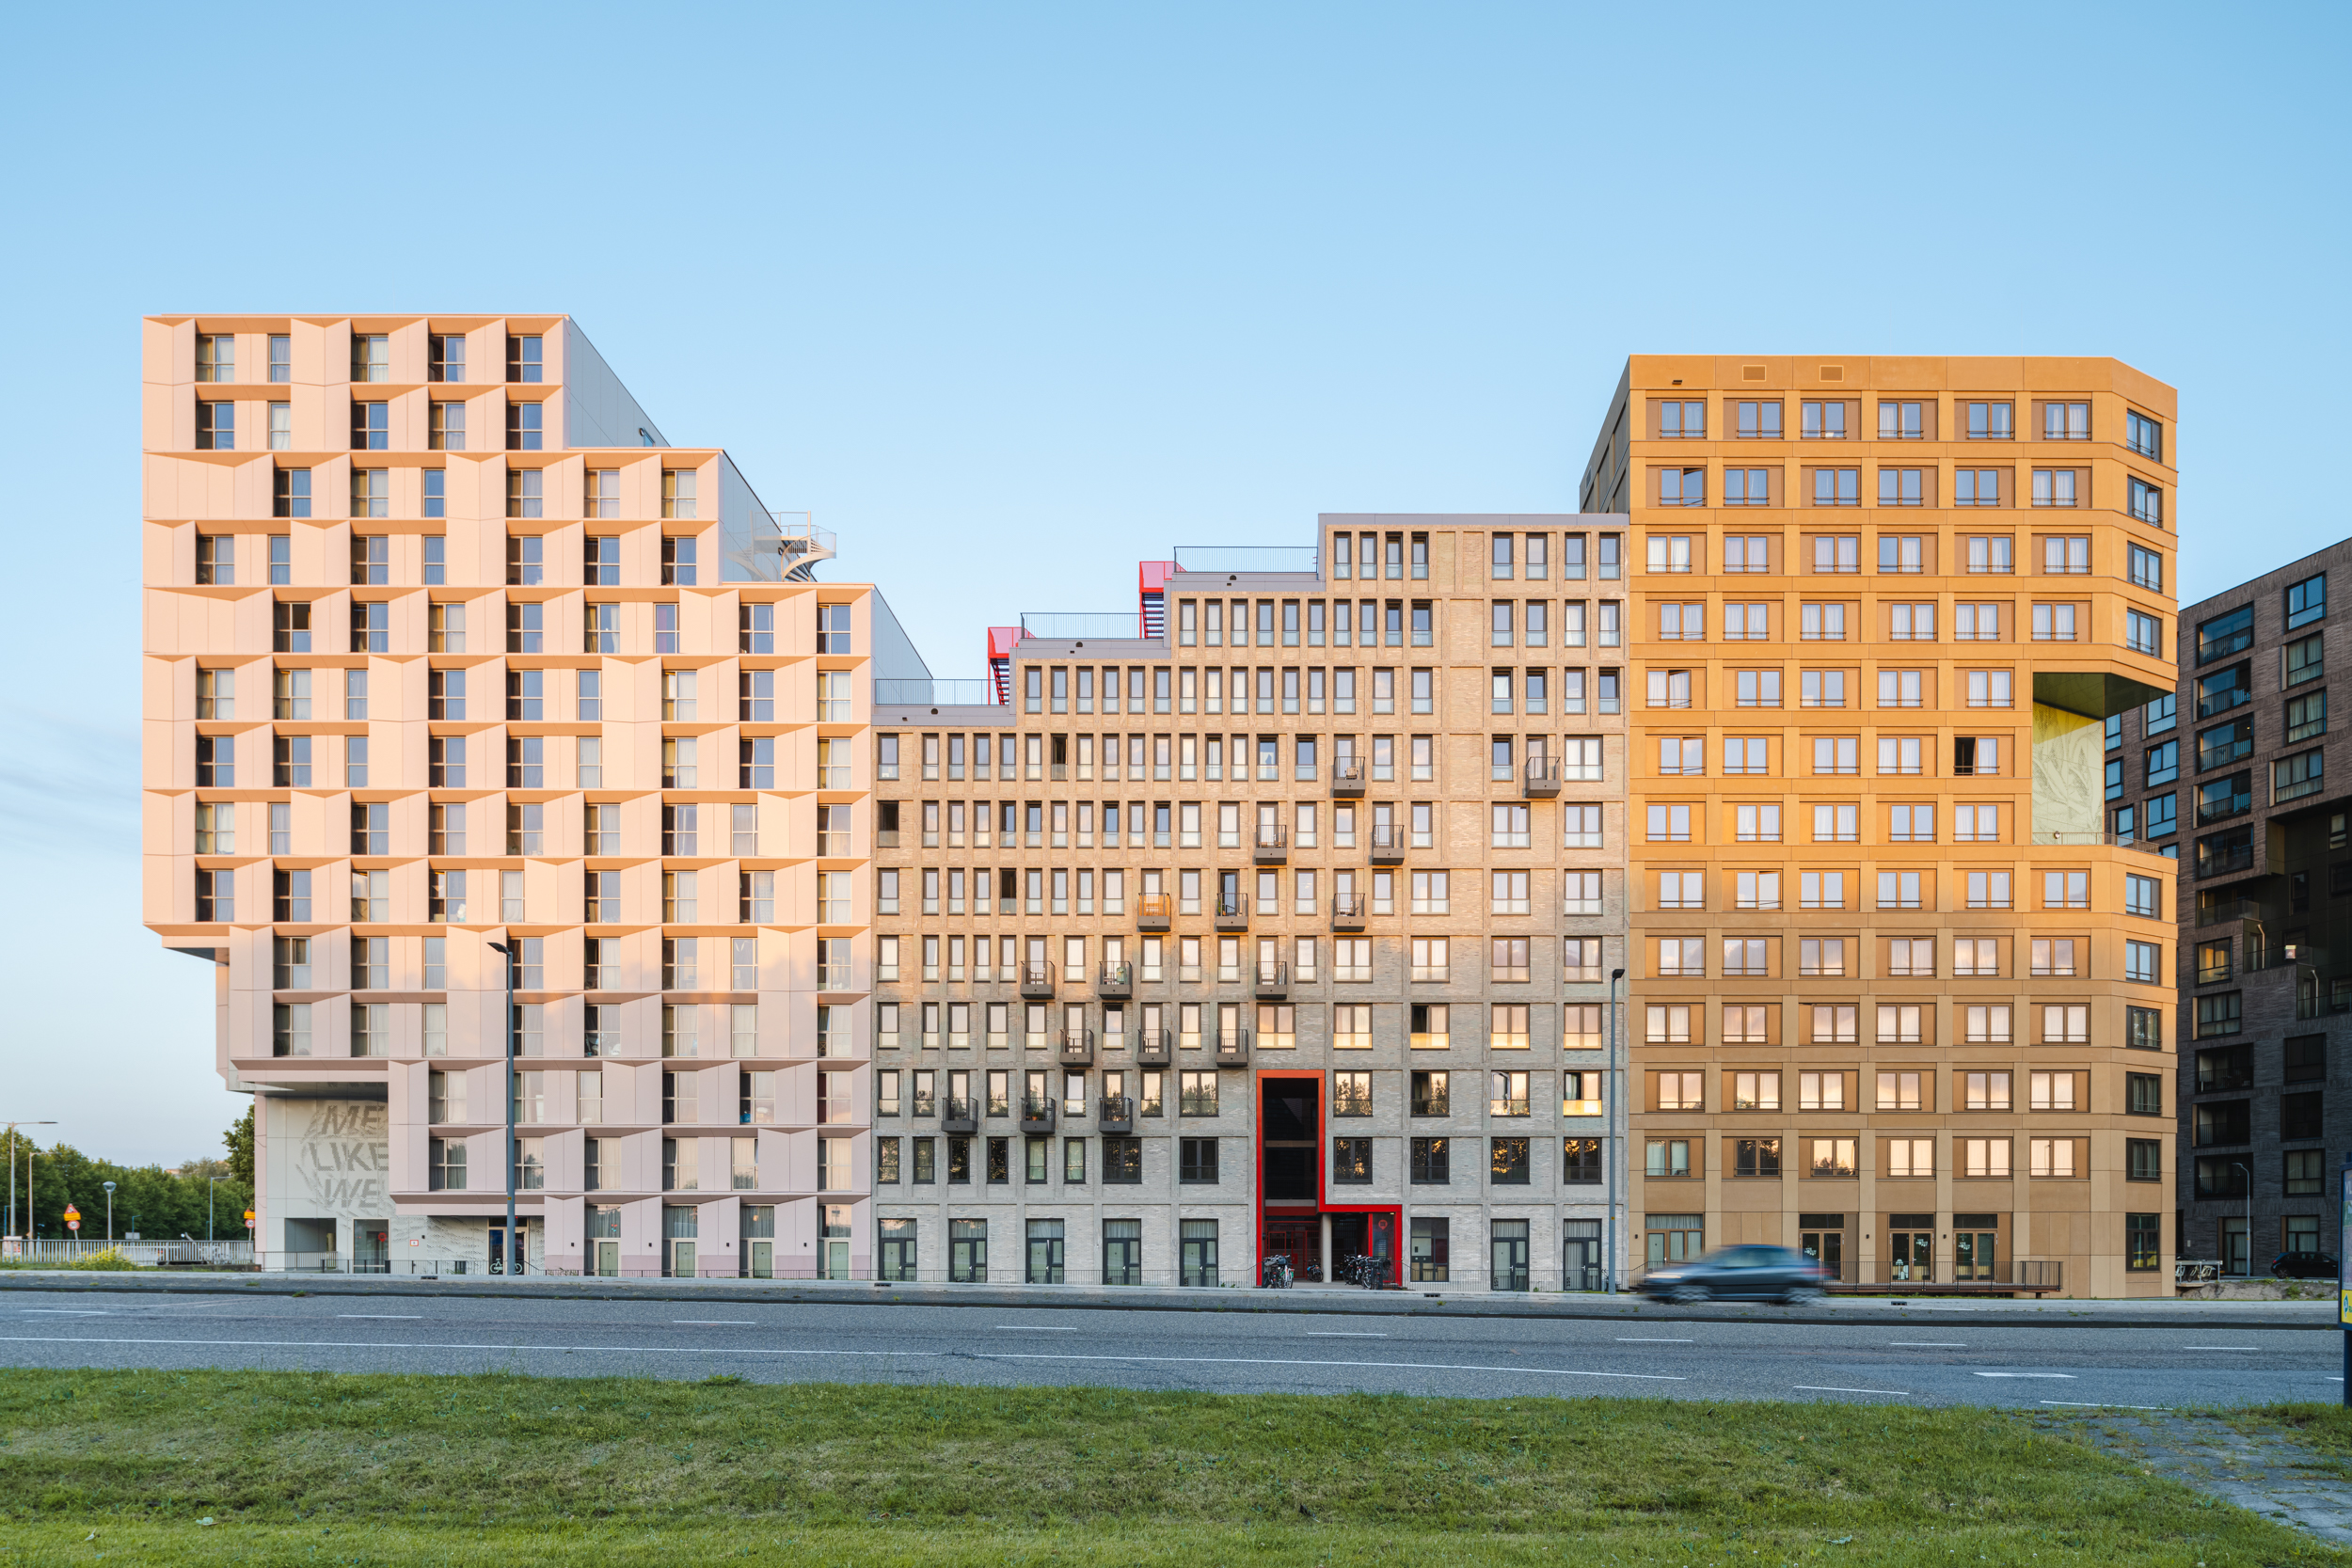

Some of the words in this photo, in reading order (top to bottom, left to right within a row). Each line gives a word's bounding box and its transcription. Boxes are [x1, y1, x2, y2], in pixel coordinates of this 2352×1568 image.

[321, 1105, 386, 1135] ME
[308, 1142, 389, 1171] LIKE
[324, 1179, 380, 1208] WE
